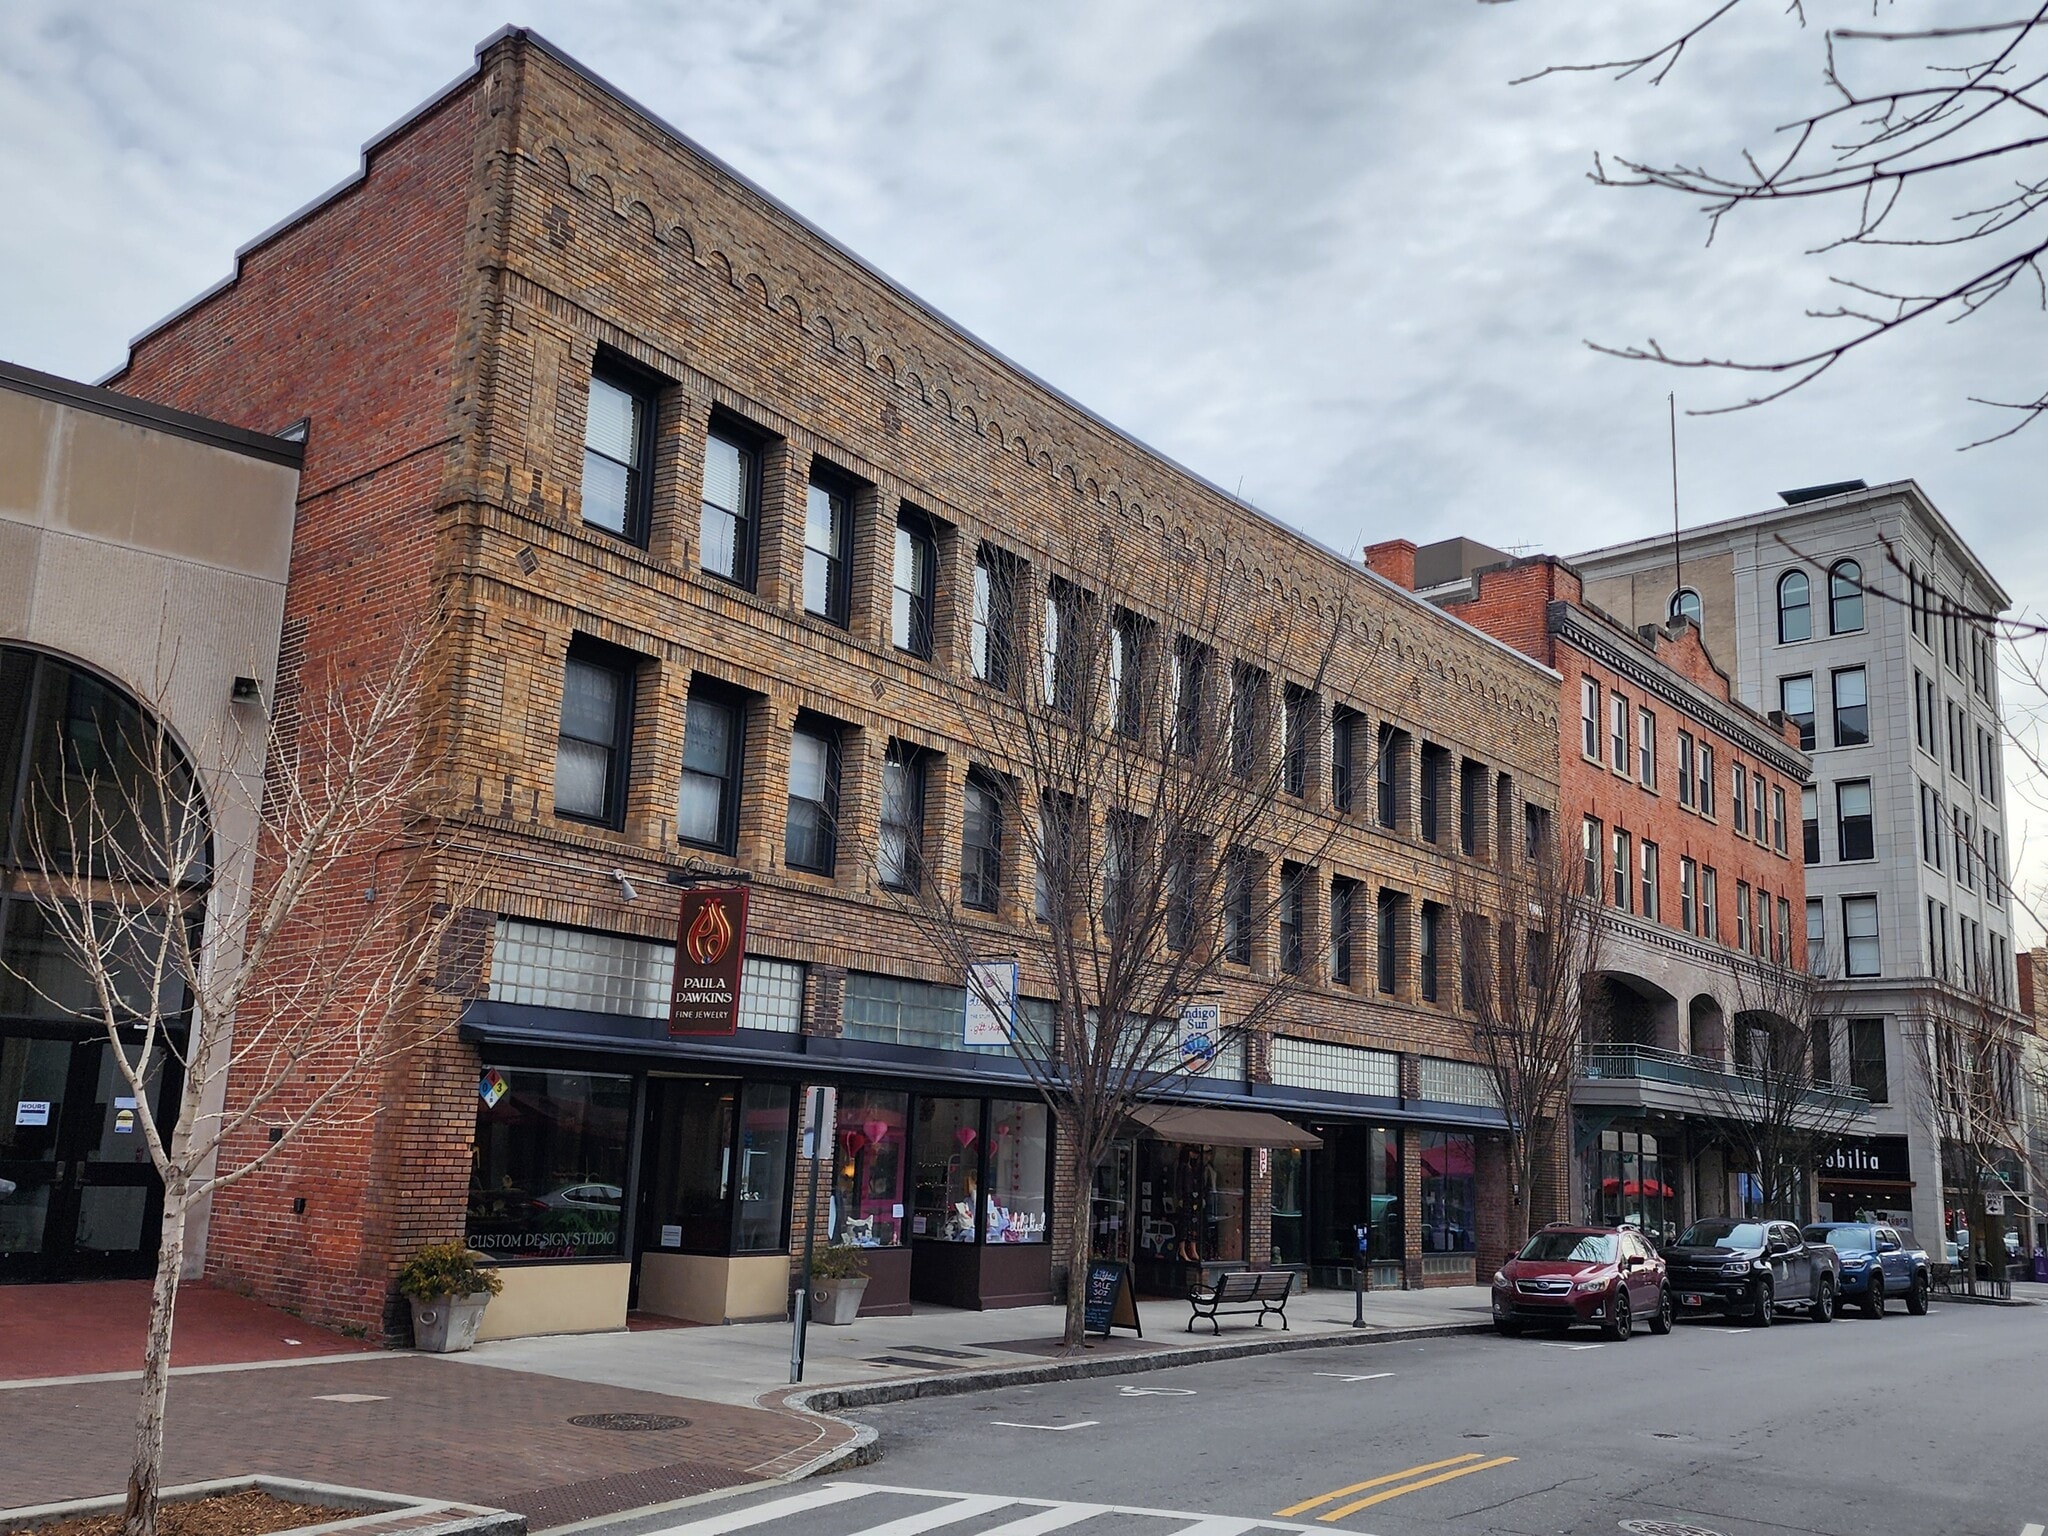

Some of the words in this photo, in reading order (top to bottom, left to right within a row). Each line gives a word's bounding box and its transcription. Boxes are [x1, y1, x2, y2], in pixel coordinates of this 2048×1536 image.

[683, 977, 726, 989] PAULA
[676, 992, 733, 1003] DAWKINS
[675, 1010, 693, 1019] FINE
[694, 1010, 729, 1019] JEWELRY
[1187, 1019, 1208, 1029] Sun
[496, 1082, 503, 1092] 3
[1820, 1148, 1879, 1170] obilia
[468, 1234, 522, 1249] CUSTOM
[525, 1232, 570, 1247] DESIGN
[572, 1231, 616, 1246] STUDIO
[1092, 1280, 1111, 1290] SALE
